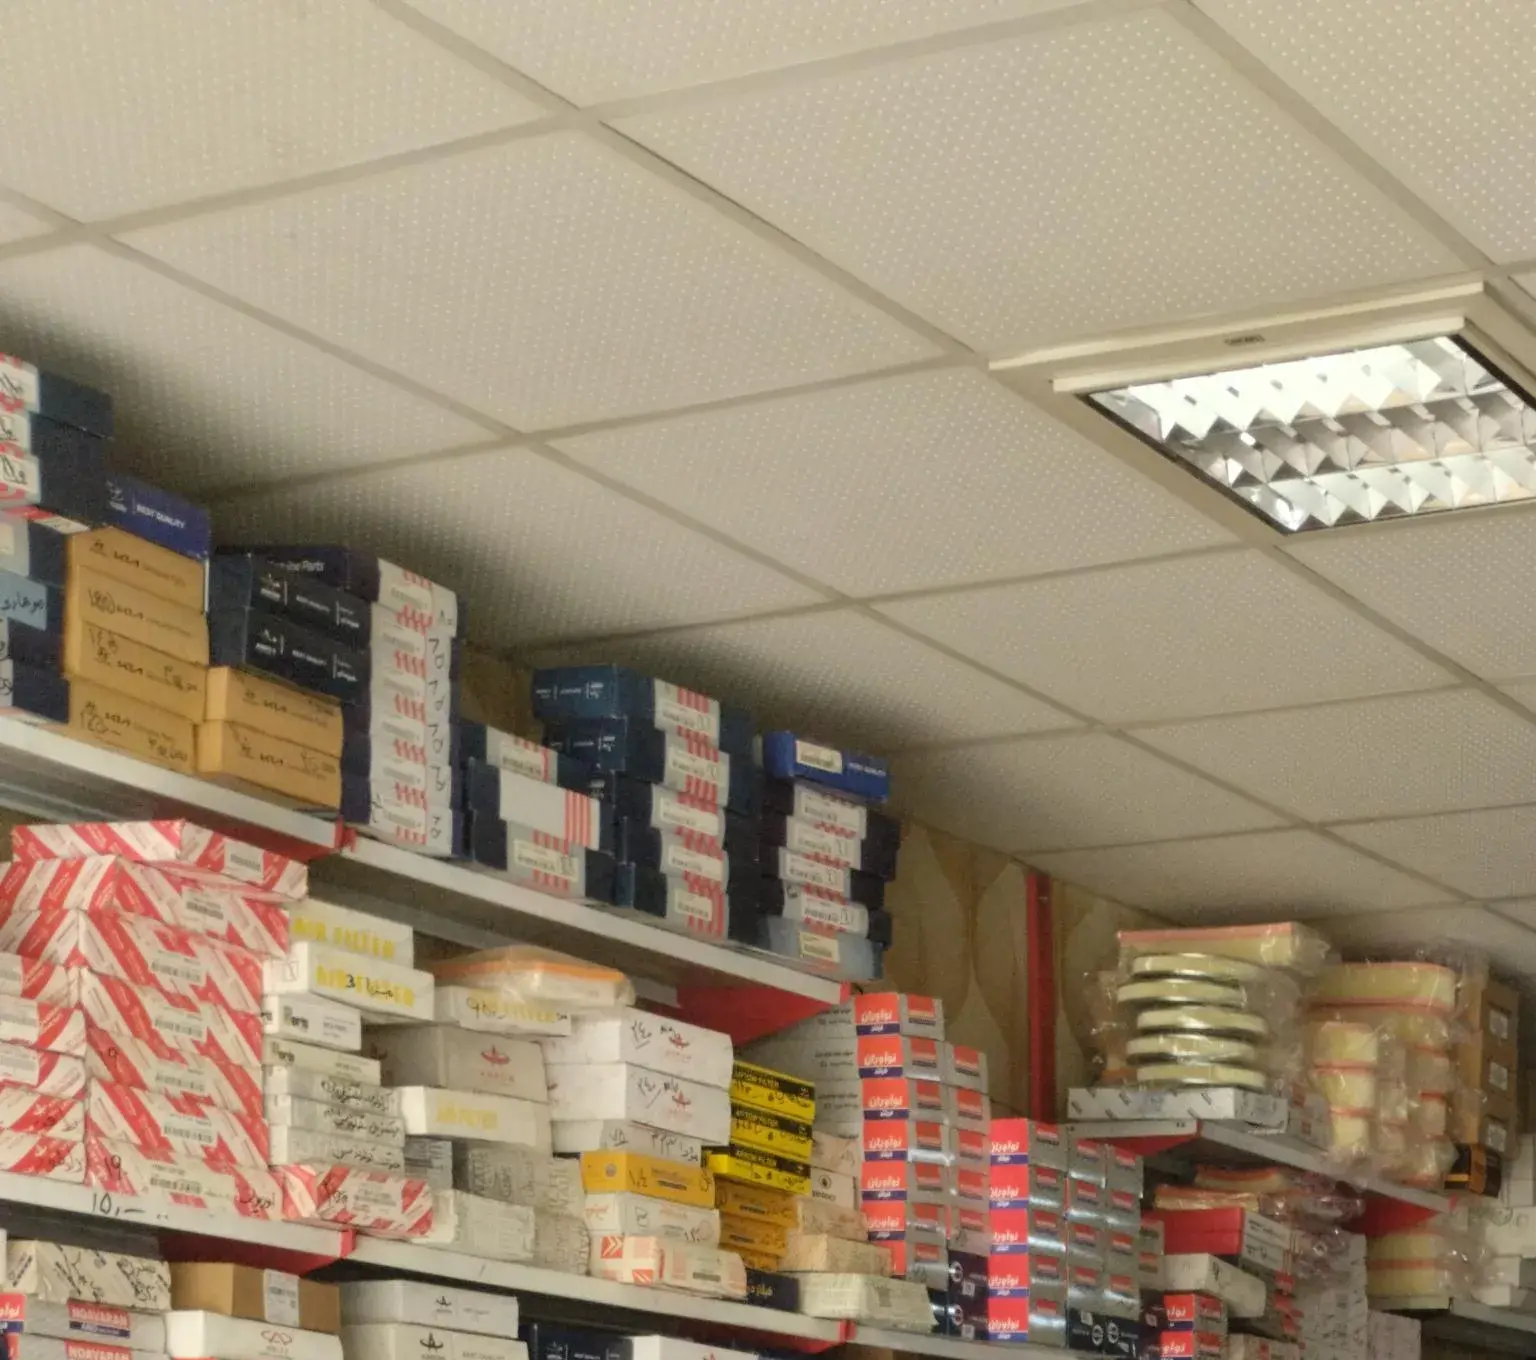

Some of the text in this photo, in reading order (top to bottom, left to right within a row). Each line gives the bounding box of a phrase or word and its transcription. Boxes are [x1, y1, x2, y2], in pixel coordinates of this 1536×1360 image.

[293, 918, 394, 959] AIR FILTER
[72, 1307, 127, 1326] NOAVARAN
